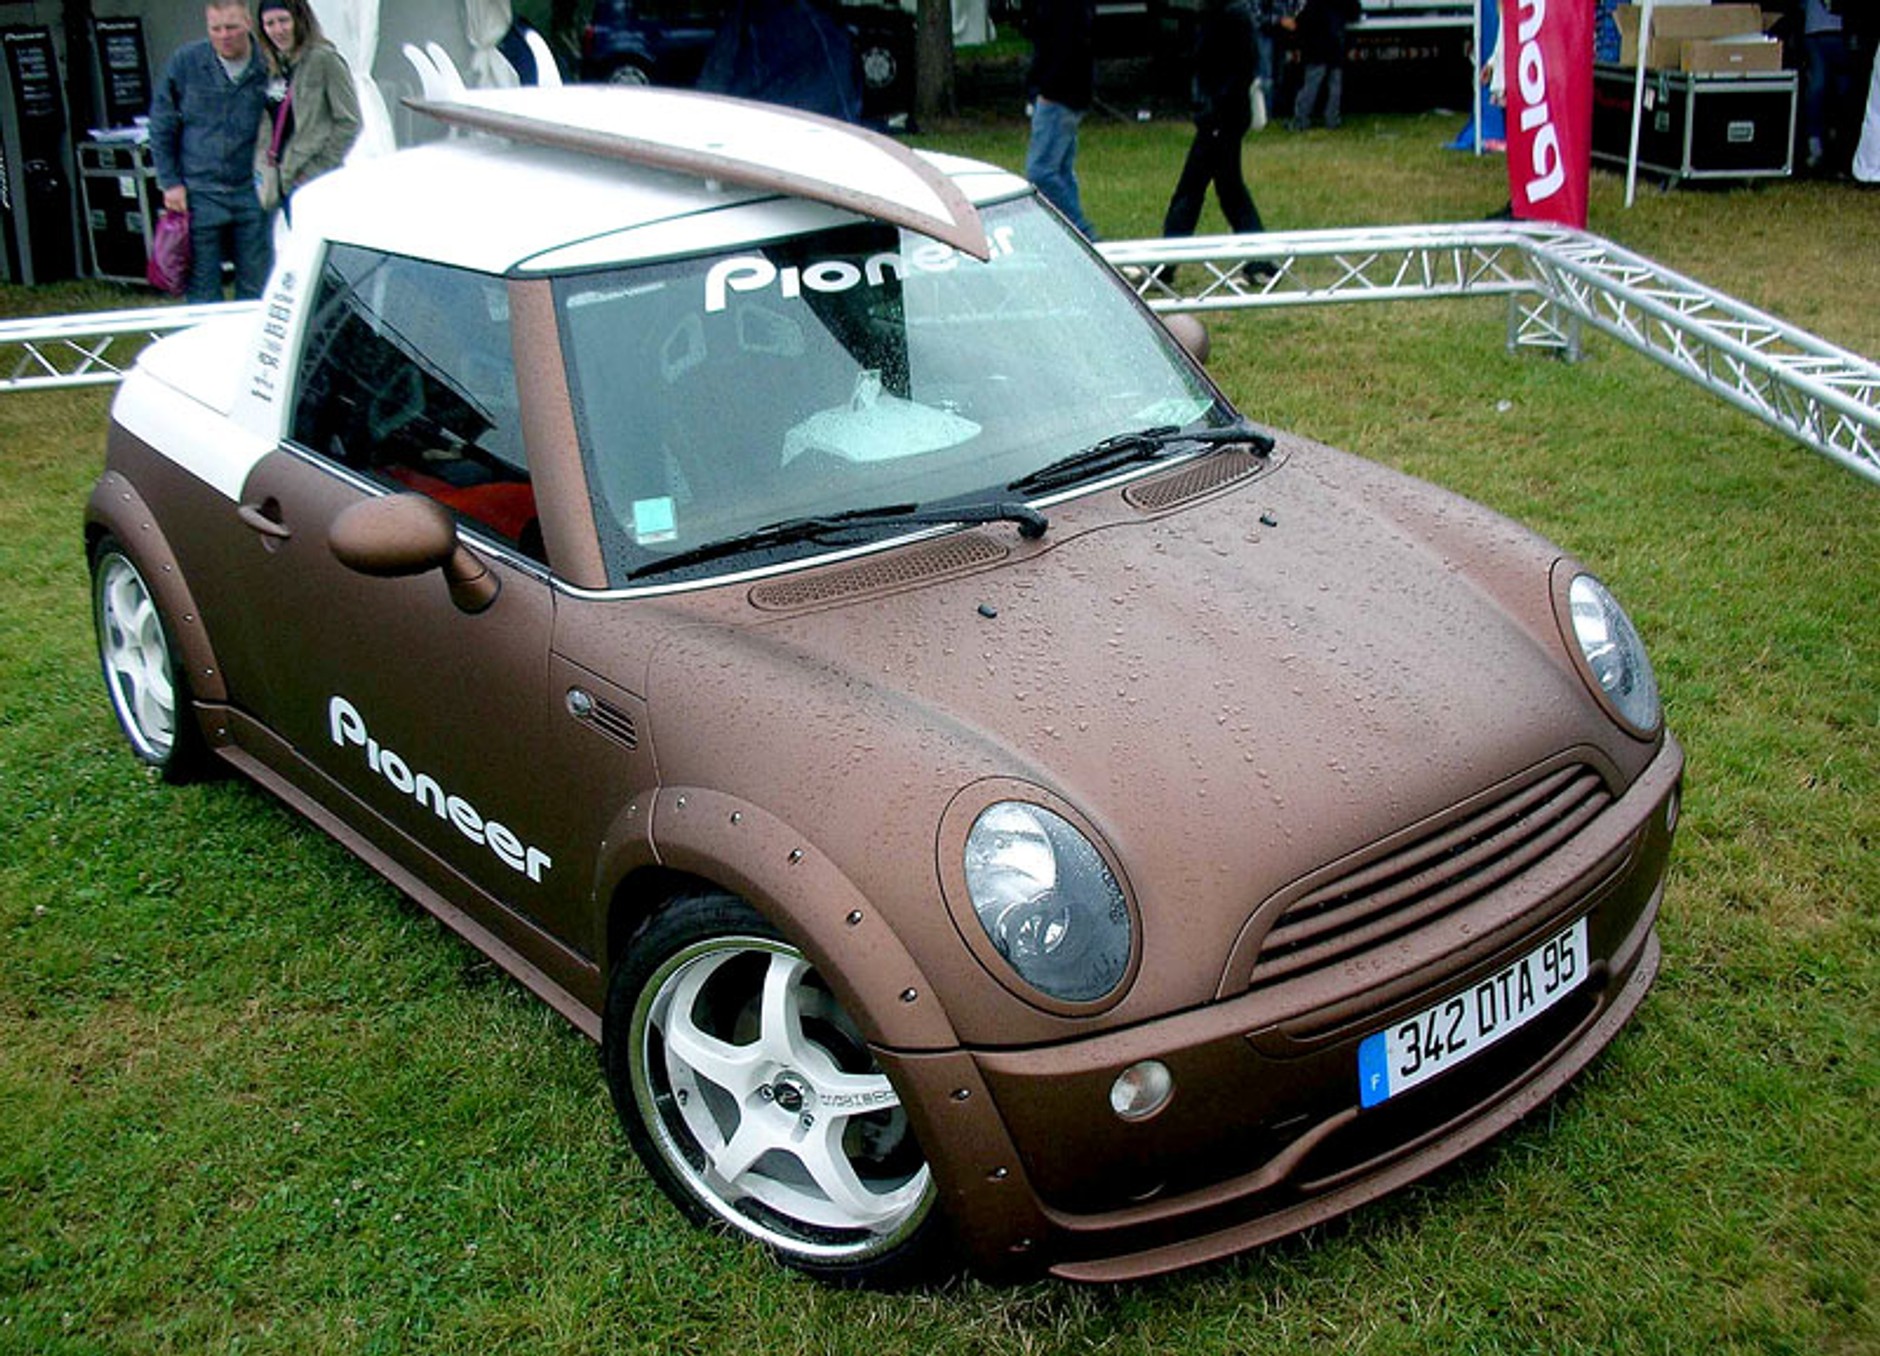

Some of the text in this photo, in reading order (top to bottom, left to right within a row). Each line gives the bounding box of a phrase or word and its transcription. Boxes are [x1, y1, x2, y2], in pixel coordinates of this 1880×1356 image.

[705, 226, 1014, 312] Pioner
[328, 694, 552, 884] Pioneer
[1398, 929, 1576, 1077] 342 DTA 95
[1370, 1073, 1381, 1091] F
